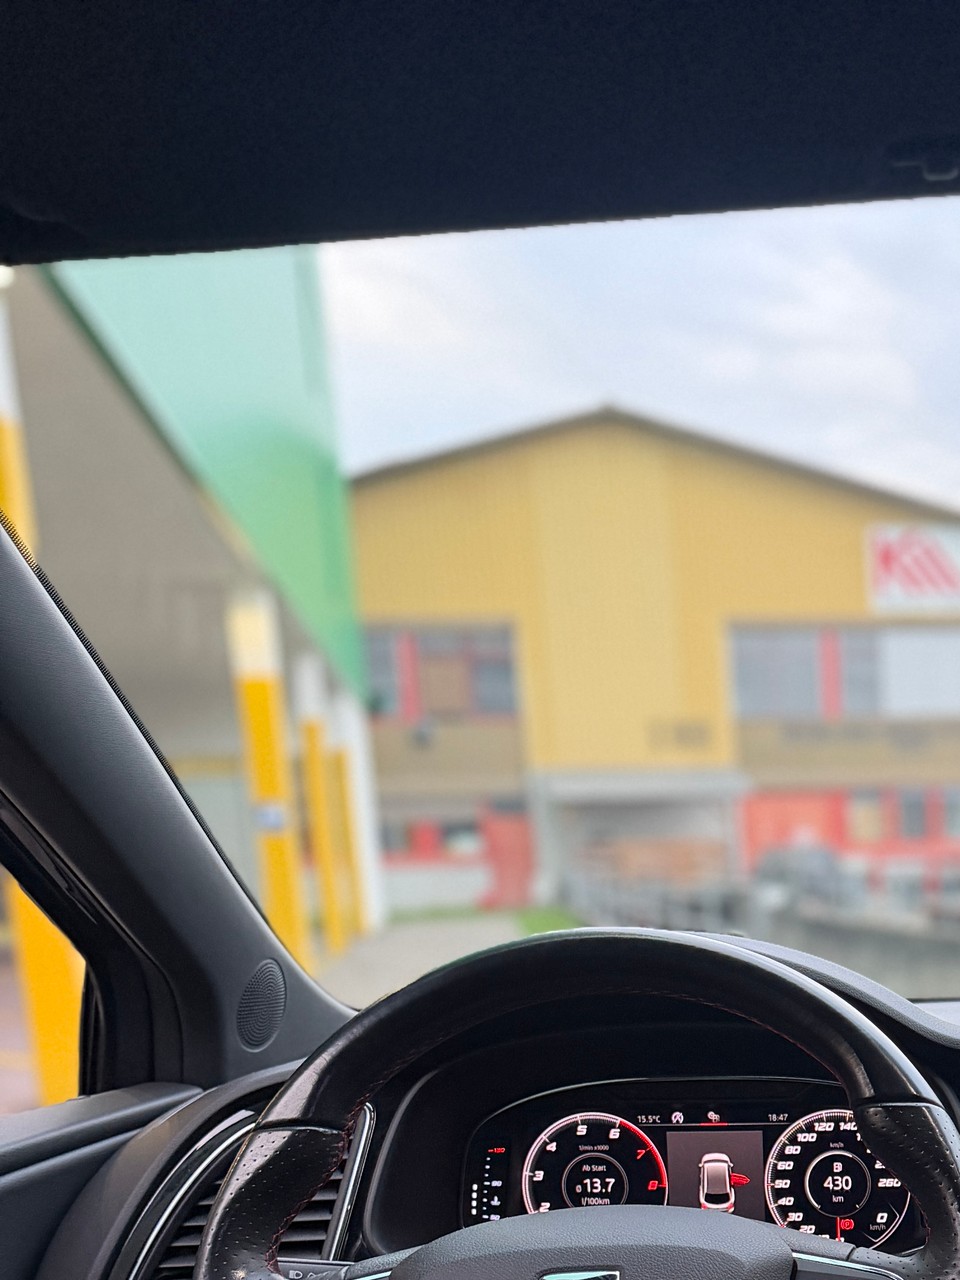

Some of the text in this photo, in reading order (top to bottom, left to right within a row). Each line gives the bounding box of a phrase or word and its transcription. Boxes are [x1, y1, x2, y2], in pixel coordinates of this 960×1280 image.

[637, 1115, 661, 1124] 15.5°C
[768, 1114, 789, 1122] 18:47
[576, 1125, 588, 1136] 5
[814, 1122, 835, 1132] 120
[609, 1129, 621, 1139] 6
[796, 1133, 818, 1142] 100
[546, 1142, 557, 1152] 4
[784, 1146, 801, 1155] 80
[636, 1149, 646, 1160] 7
[582, 1164, 592, 1172] Ab
[777, 1161, 794, 1170] 60
[533, 1170, 544, 1181] 3
[583, 1178, 616, 1193] 13.7
[774, 1179, 791, 1189] 50
[823, 1175, 852, 1191] 430
[877, 1178, 902, 1187] 260
[777, 1196, 795, 1206] 40
[832, 1195, 844, 1203] km
[539, 1202, 551, 1213] 2
[787, 1212, 804, 1222] 30
[876, 1212, 888, 1224] 0
[869, 1223, 887, 1231] km/h
